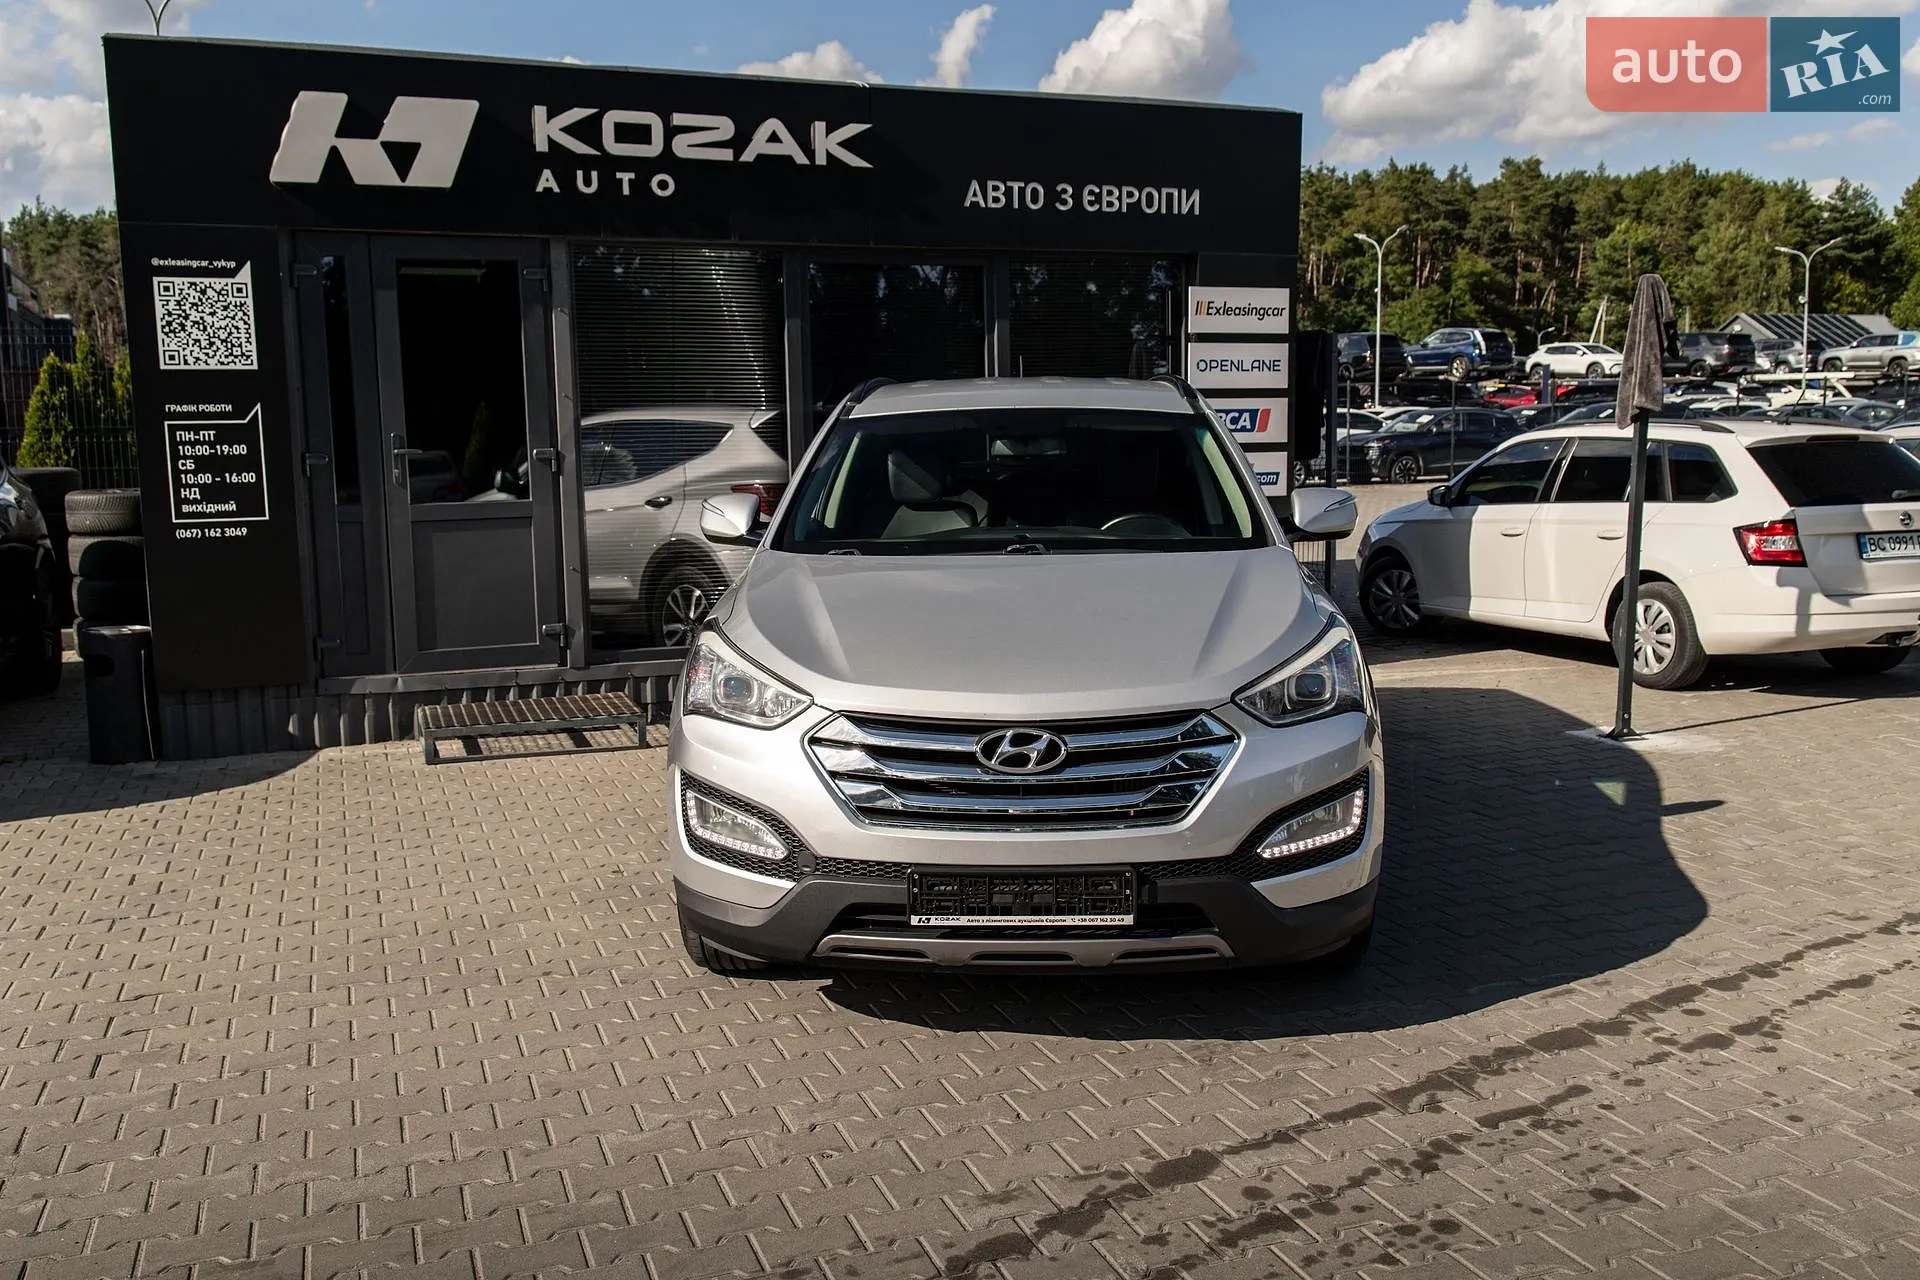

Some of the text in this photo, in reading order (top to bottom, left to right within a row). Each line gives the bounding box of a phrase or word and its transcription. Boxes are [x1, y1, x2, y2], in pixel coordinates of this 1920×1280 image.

[532, 105, 874, 168] KOZAK
[535, 169, 675, 197] AUTO
[963, 179, 1045, 210] АВТО
[1082, 184, 1200, 215] ЄВРОПИ
[151, 257, 236, 268] @exleasingcar_vykyp
[1206, 301, 1286, 321] Exleasingcar
[1196, 359, 1282, 372] OPENLANE
[165, 404, 232, 412] ГРАФІК РОБОТИ
[176, 431, 216, 441] ПН-ПТ
[178, 444, 247, 456] 10:00-19:00
[178, 460, 195, 470] СБ
[180, 473, 212, 484] 10:00
[225, 472, 256, 483] 16:00
[181, 488, 200, 500] НД
[181, 501, 237, 513] вихідний
[176, 527, 248, 539] (067) 162 3049
[1868, 537, 1886, 552] BC
[1888, 535, 1915, 550] 0991
